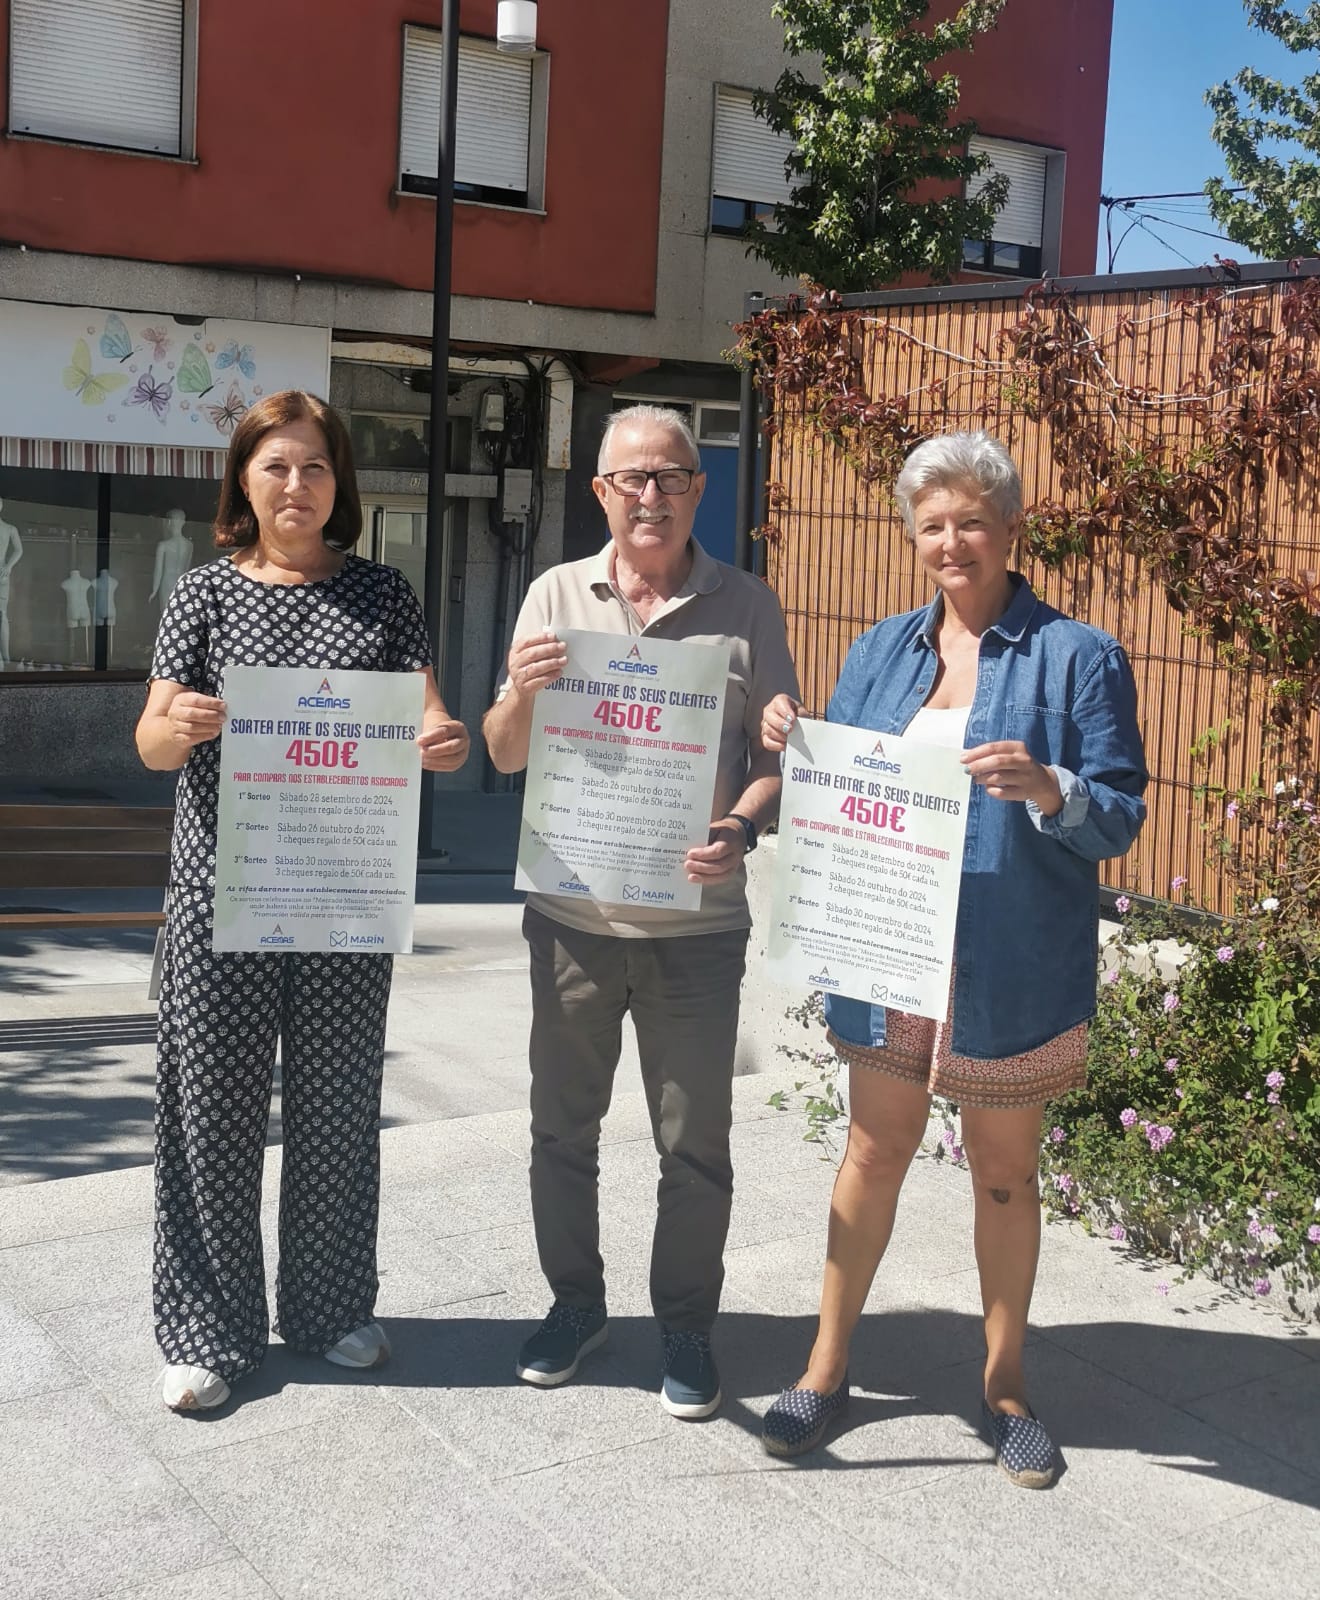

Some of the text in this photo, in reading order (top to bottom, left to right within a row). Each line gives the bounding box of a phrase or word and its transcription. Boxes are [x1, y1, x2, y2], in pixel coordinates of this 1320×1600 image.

[608, 660, 657, 675] ACEMAS
[587, 681, 619, 697] ENTRE
[622, 685, 636, 700] OS
[639, 687, 666, 704] SEUS
[669, 691, 717, 709] CLIENTES
[298, 696, 350, 709] ACEMAS
[594, 701, 661, 732] 450€
[231, 718, 415, 740] SORTEA ENTRE OS SEUS CLIENTES
[544, 725, 706, 754] PARA COMPRAS NOS ESTABLECEMENTOS ASOCIADOS
[286, 740, 358, 768] 450€
[555, 745, 577, 755] Sorteo
[853, 755, 901, 774] ACEMAS
[233, 772, 407, 787] PARA COMPRAS NOS ESTABLECEMENTOS ASOCIADOS
[552, 773, 574, 783] Sorteo
[247, 792, 271, 800] Sorteo
[791, 767, 831, 786] SORTEA
[833, 774, 864, 794] ENTRE
[867, 782, 881, 797] OS
[884, 785, 910, 804] SEUS
[912, 792, 960, 815] CLIENTES
[548, 804, 570, 813] Sorteo
[841, 796, 905, 832] 450€
[577, 807, 686, 830] Sábado 30 novembro do 2024
[245, 822, 269, 831] Sorteo
[791, 817, 949, 860] PARA COMPRAS NOS ESTABLECEMENTOS ASOCIADOS
[803, 837, 824, 848] Sorteo
[243, 855, 267, 864] Sorteo
[275, 855, 391, 868] Sábado 30 novembro do 2024
[800, 866, 822, 877] Sorteo
[642, 890, 674, 900] MARÍN
[797, 896, 819, 907] Sorteo
[825, 902, 931, 935] Sábado 30 novembro do 2024
[350, 935, 384, 944] MARÍN
[890, 992, 921, 1006] MARÍN
